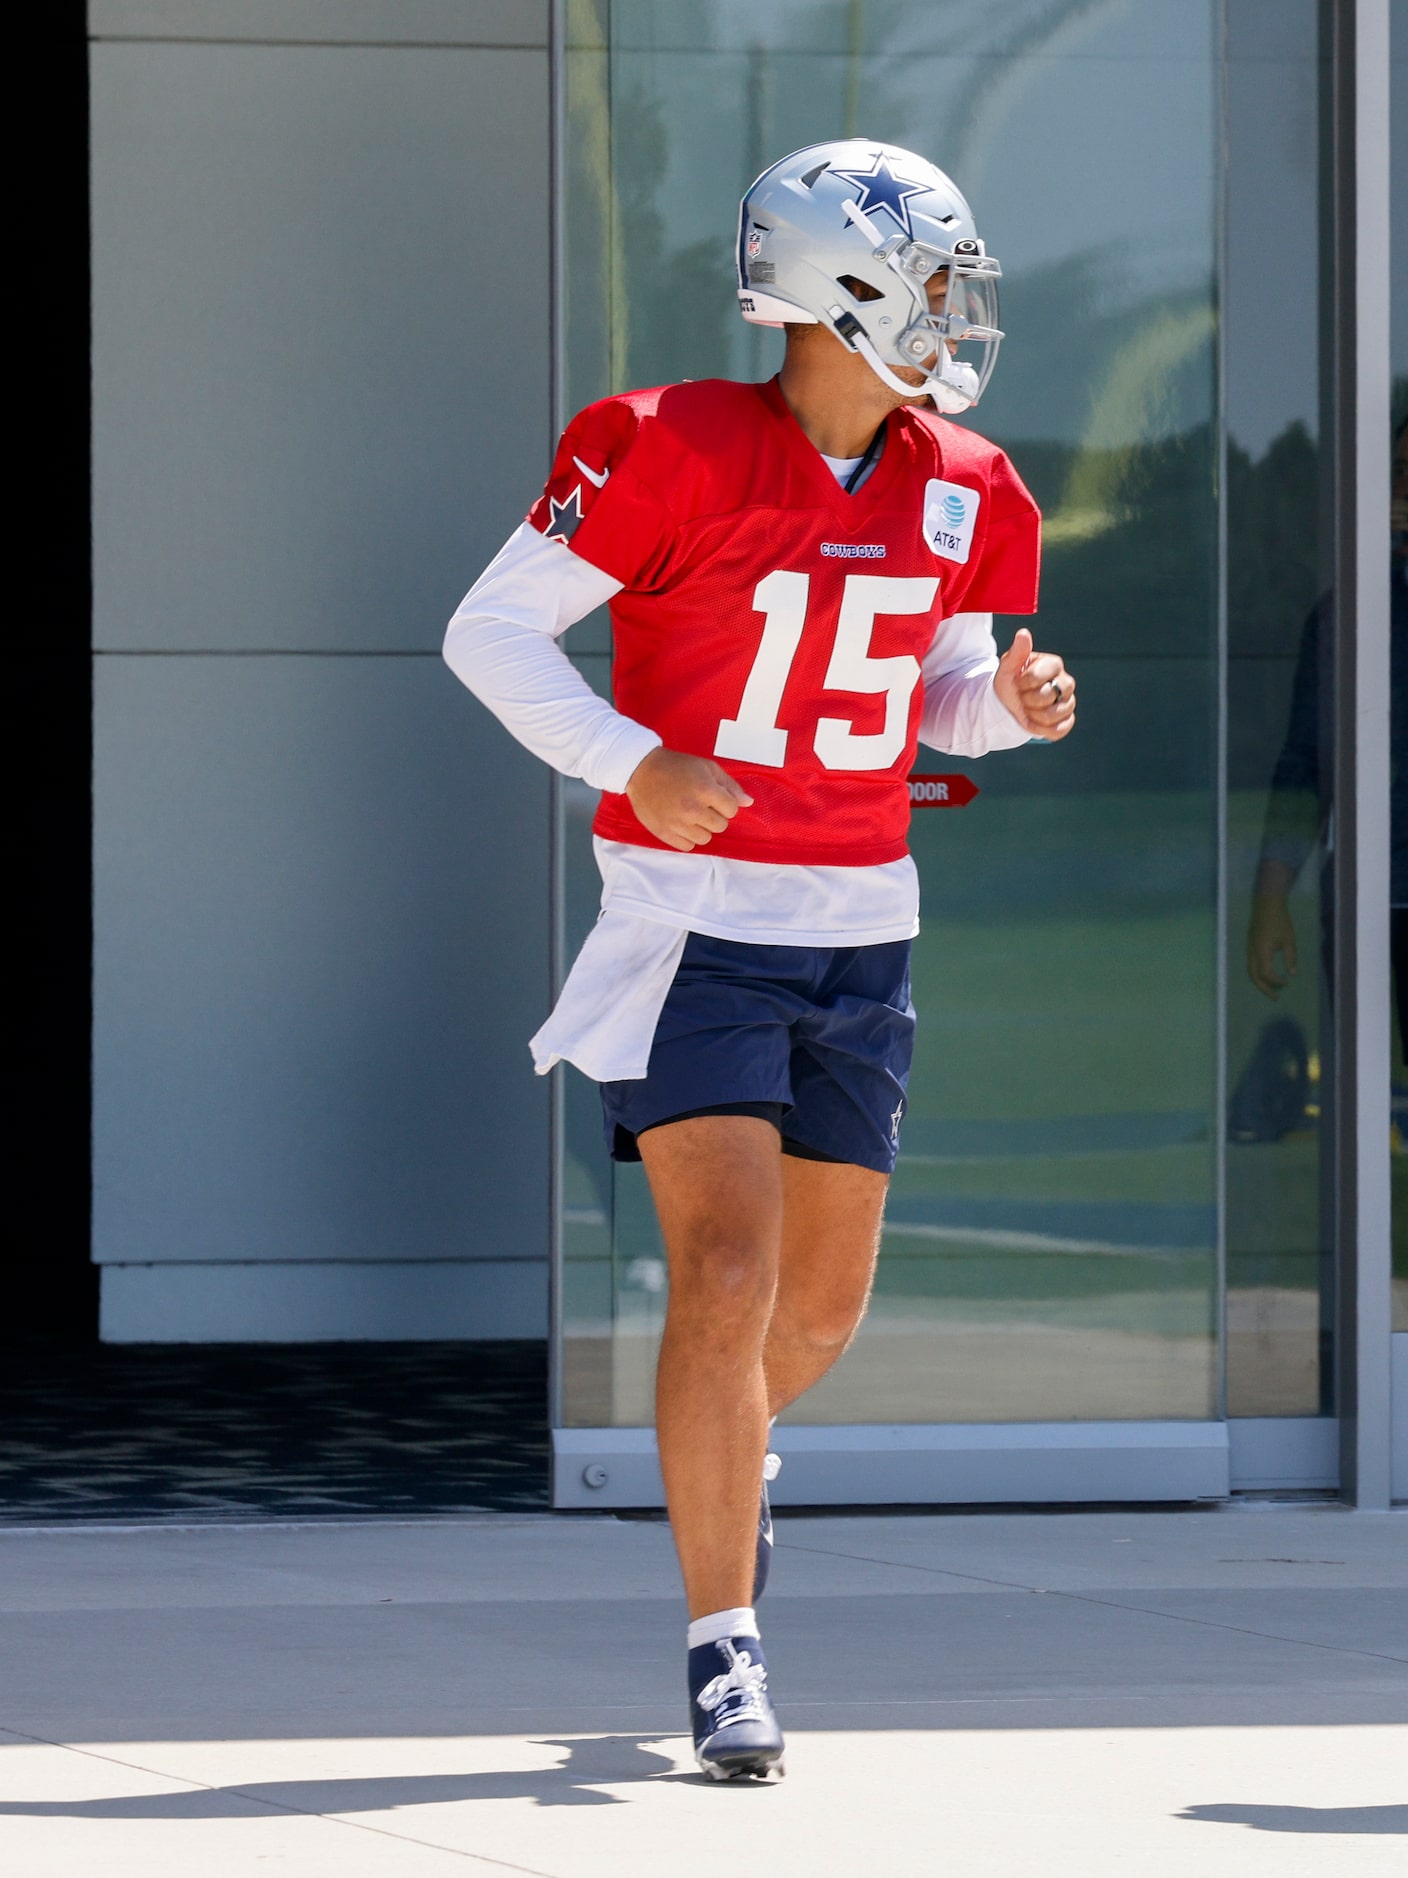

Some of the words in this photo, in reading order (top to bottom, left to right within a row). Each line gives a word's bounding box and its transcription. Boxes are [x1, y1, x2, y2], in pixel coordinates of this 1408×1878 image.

[820, 542, 886, 559] COWBOYS
[933, 530, 961, 551] AT&T
[713, 570, 940, 771] 15
